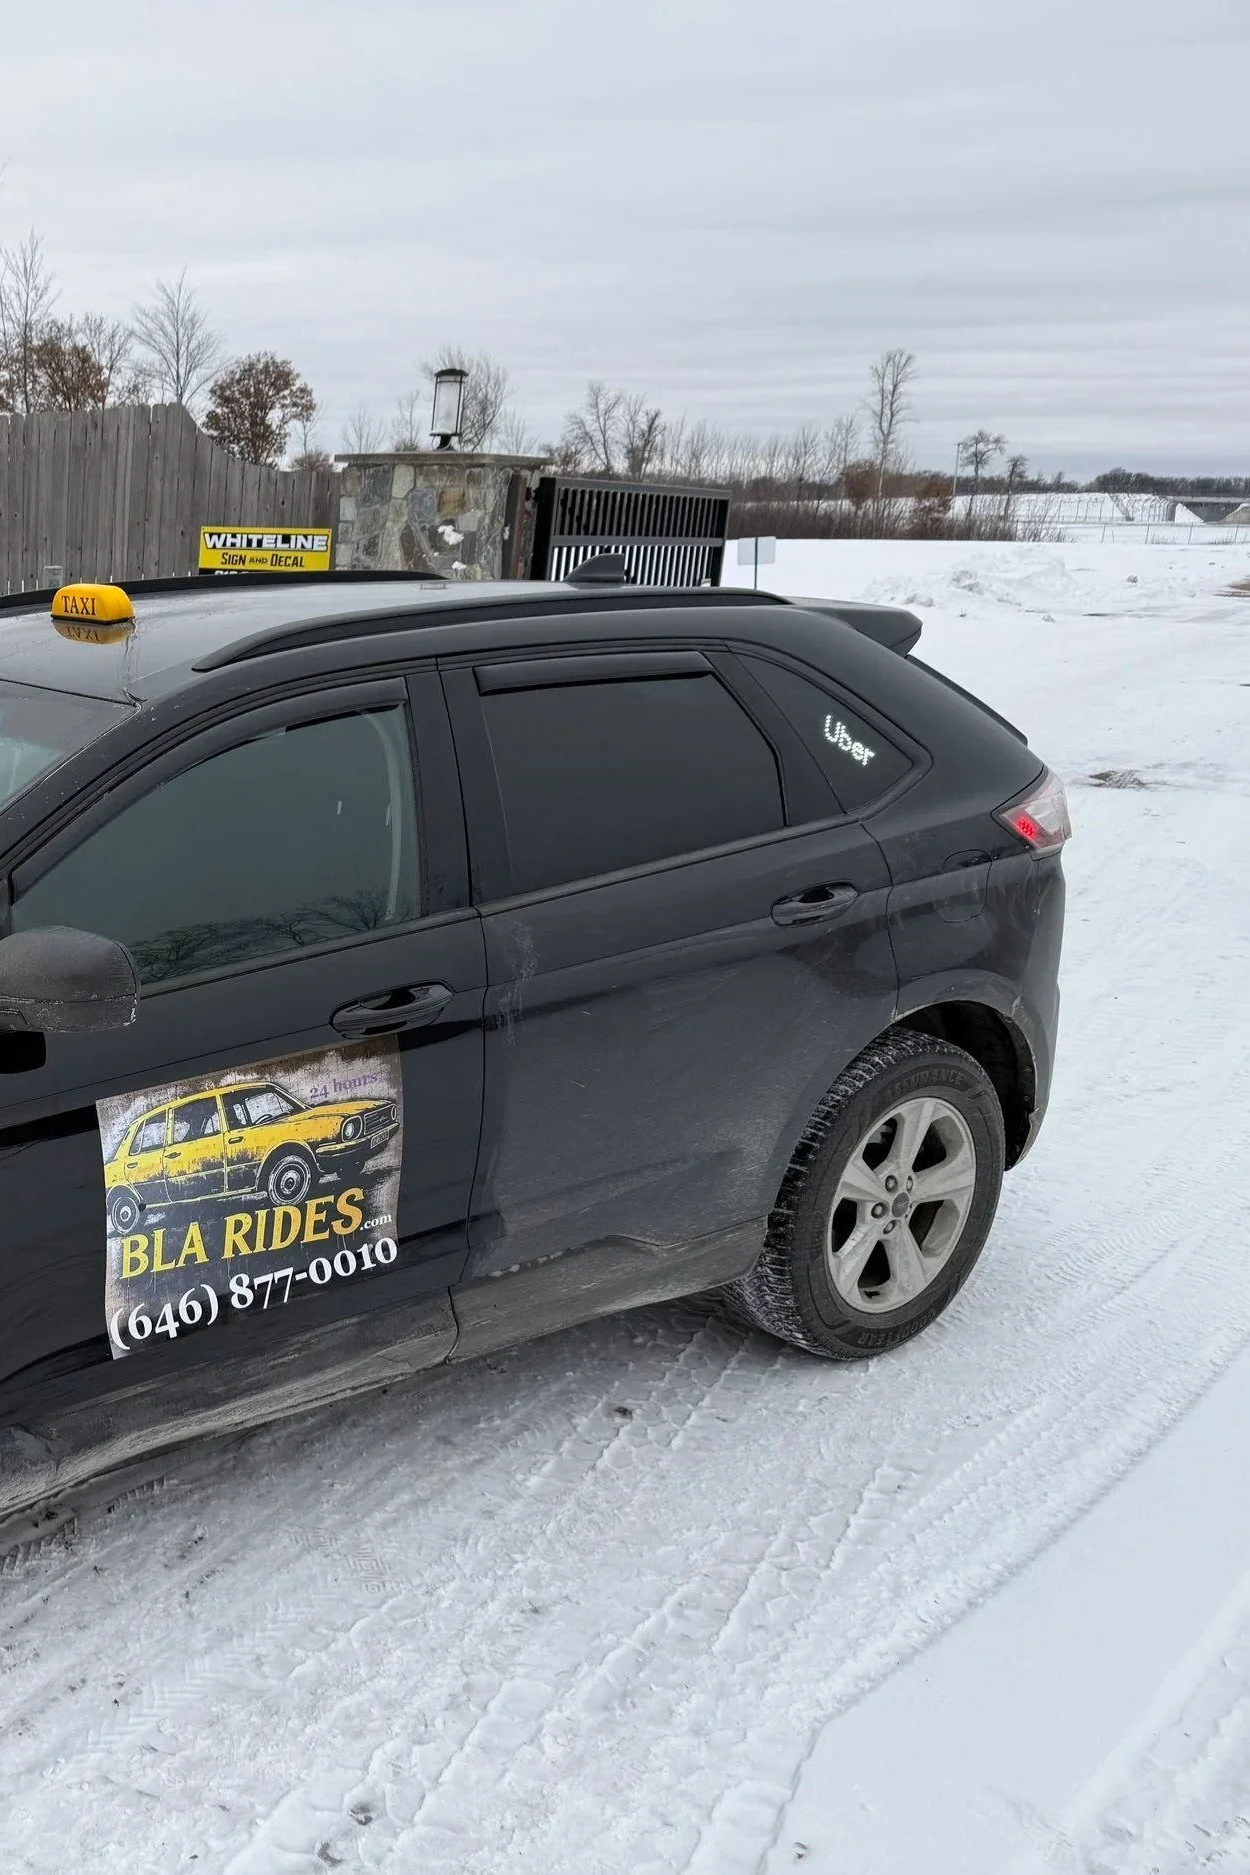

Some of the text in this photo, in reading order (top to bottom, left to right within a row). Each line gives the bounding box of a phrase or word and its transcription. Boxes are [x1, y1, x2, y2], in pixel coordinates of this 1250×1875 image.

[204, 533, 328, 551] WHITELINE
[221, 552, 246, 566] SIGN
[270, 555, 305, 568] DECAL
[61, 595, 97, 616] TAXI
[823, 714, 876, 766] Uber
[309, 1073, 378, 1099] 24 hours
[119, 1187, 393, 1280] BLA RIDES .com
[109, 1237, 399, 1350] (646) 877-0010
